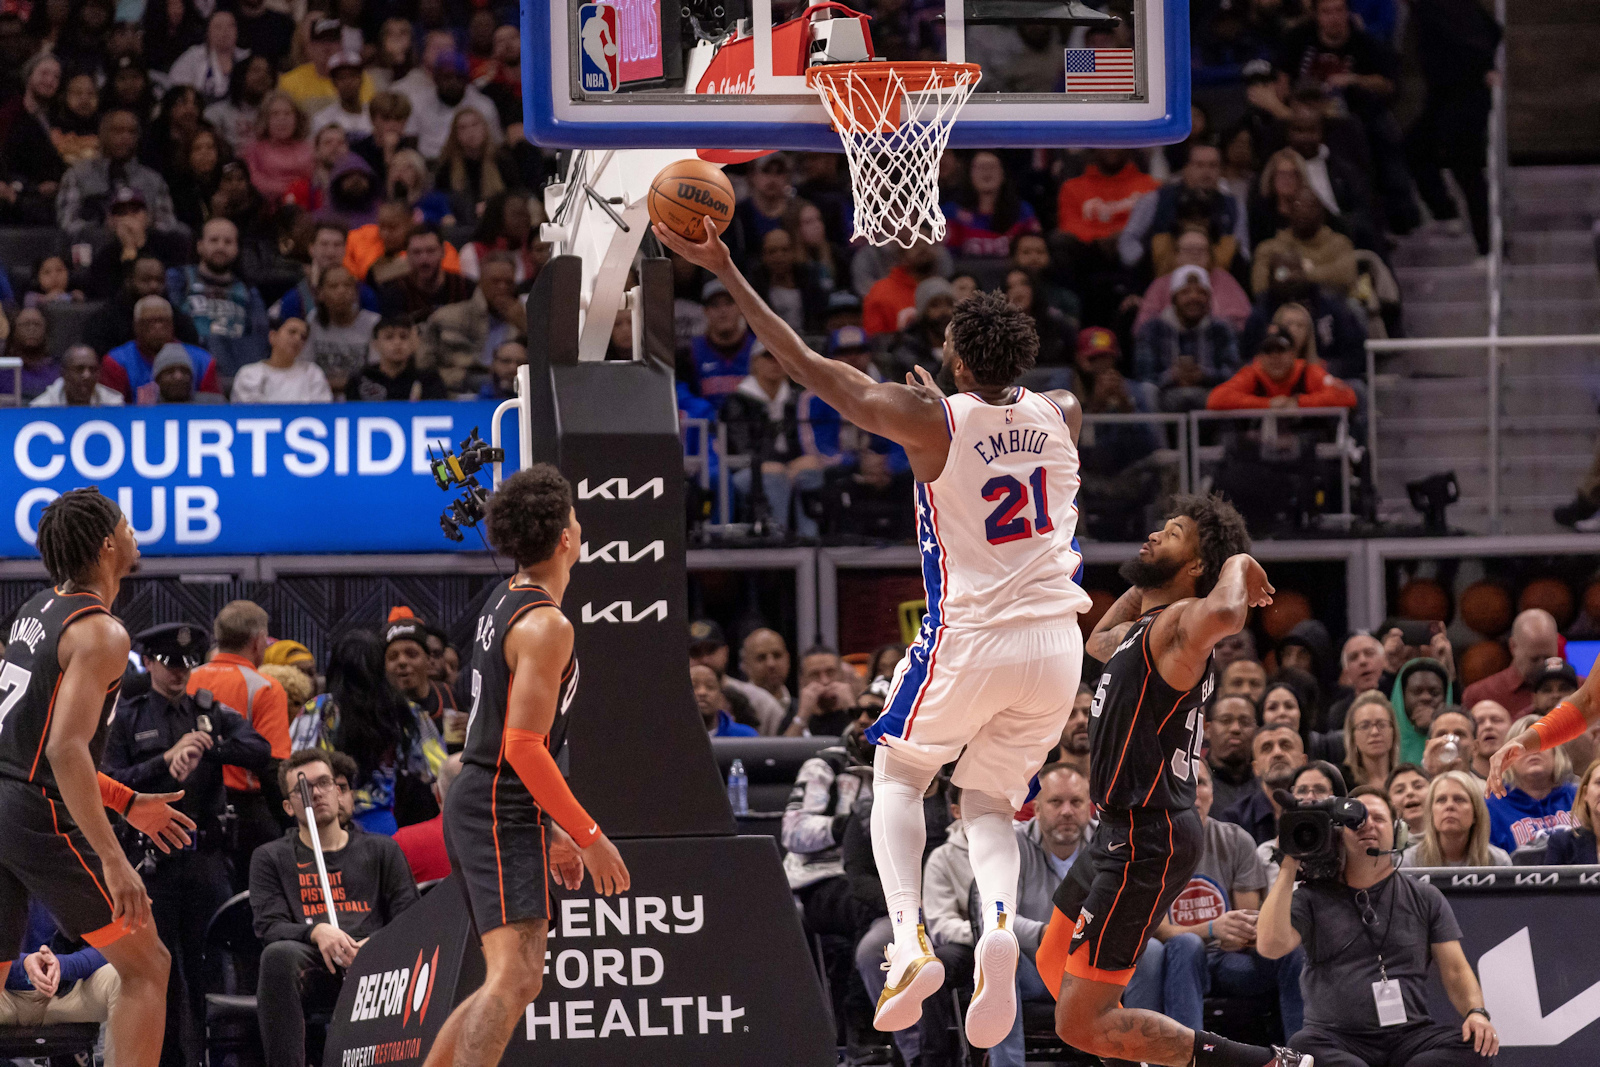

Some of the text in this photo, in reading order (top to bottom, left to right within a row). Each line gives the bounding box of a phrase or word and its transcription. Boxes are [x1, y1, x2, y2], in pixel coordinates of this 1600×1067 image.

[586, 73, 605, 88] NBA
[677, 182, 729, 217] Wilson
[13, 416, 454, 482] COURTSIDE
[973, 429, 1049, 466] EMBIID
[15, 485, 222, 547] CUB
[981, 466, 1055, 546] 21
[298, 871, 342, 887] DETOIT
[300, 886, 346, 903] PISTNS
[547, 895, 704, 938] ENRY
[1177, 906, 1218, 922] PISTONS
[1179, 895, 1215, 911] DETROIT
[350, 968, 410, 1022] BELFOR
[525, 995, 745, 1041] HEALTH
